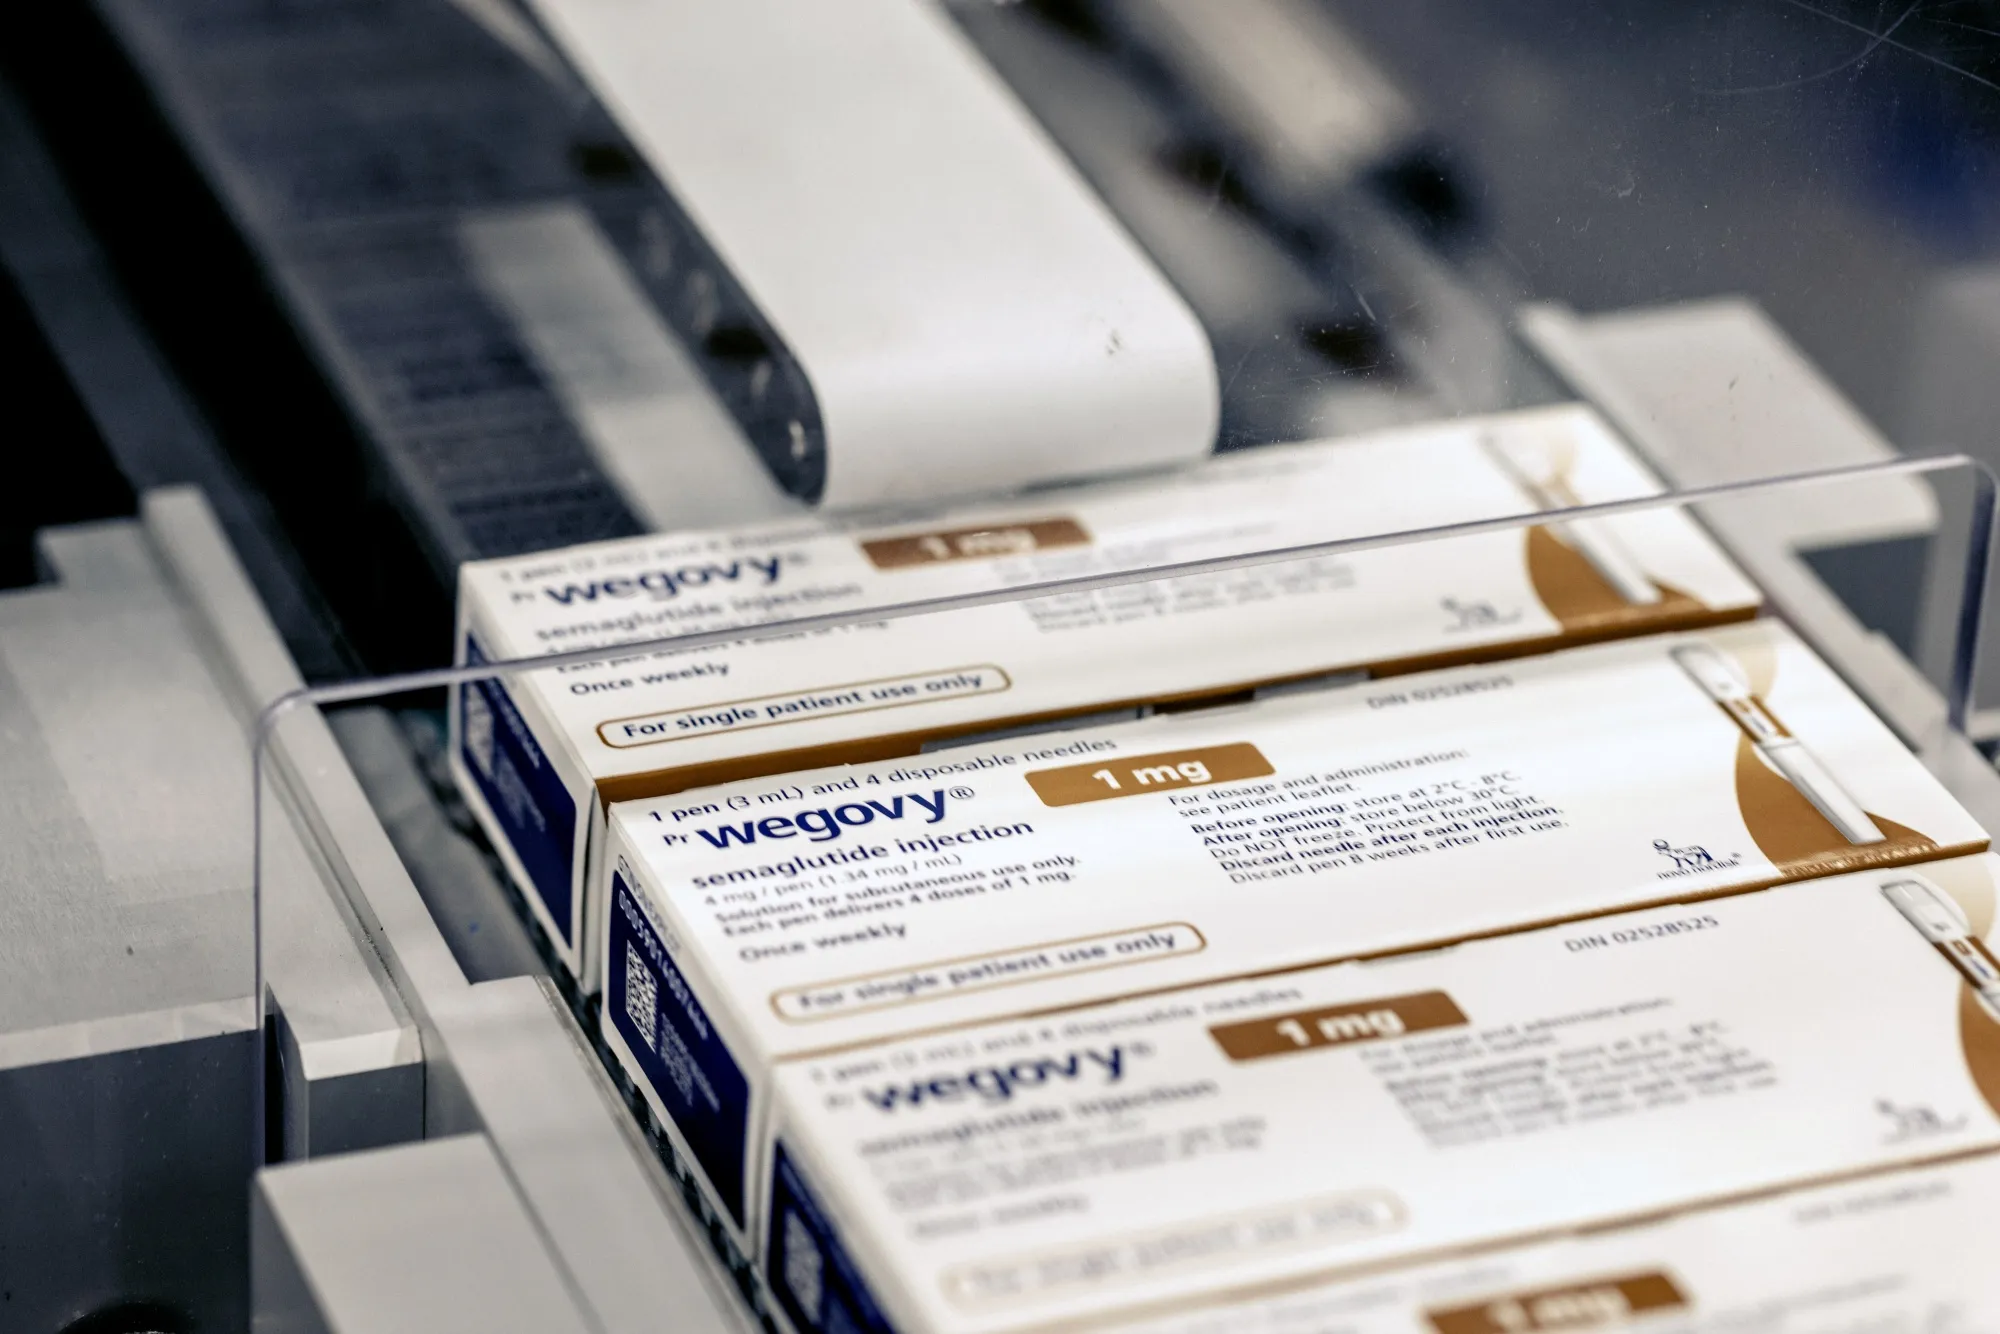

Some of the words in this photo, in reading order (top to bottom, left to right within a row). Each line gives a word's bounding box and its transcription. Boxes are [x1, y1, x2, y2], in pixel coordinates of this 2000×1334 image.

[569, 678, 634, 696] Once
[640, 661, 729, 685] weekly
[623, 721, 666, 738] For
[676, 704, 758, 731] single
[765, 690, 865, 720] patient
[871, 684, 917, 700] use
[925, 671, 983, 695] only
[649, 810, 661, 822] 1
[671, 801, 720, 823] pen
[726, 795, 750, 814] (3
[757, 784, 804, 806] mL)
[812, 776, 860, 796] and
[866, 773, 881, 786] 4
[888, 753, 1017, 784] disposable
[1023, 739, 1117, 763] needles
[1092, 769, 1122, 790] 1
[1131, 760, 1213, 787] mg
[1168, 793, 1200, 807] For
[1207, 781, 1276, 803] dosage
[1281, 773, 1318, 789] and
[1178, 805, 1212, 819] see
[1217, 792, 1288, 815] patient
[1291, 781, 1362, 802] leaflet.
[1190, 815, 1257, 835] Before
[1262, 801, 1349, 825] opening:
[1354, 791, 1402, 810] store
[1407, 787, 1427, 800] at
[1202, 830, 1253, 847] After
[1259, 816, 1345, 839] opening:
[1350, 806, 1400, 825] store
[1403, 794, 1464, 815] below
[1208, 846, 1240, 860] Do
[1244, 838, 1286, 854] NOT
[1294, 828, 1362, 848] freeze.
[1364, 812, 1437, 835] Protect
[1440, 804, 1489, 822] from
[1491, 794, 1545, 814] light.
[662, 833, 689, 847] Pr
[692, 841, 890, 890] semaglutide
[898, 818, 1036, 856] injection
[1219, 849, 1294, 872] Discard
[1300, 838, 1366, 860] needle
[1371, 830, 1418, 849] after
[1422, 820, 1469, 839] each
[1473, 805, 1565, 831] injection.
[1228, 862, 1303, 885] Discard
[1307, 856, 1347, 876] pen
[1350, 853, 1364, 865] 8
[1367, 842, 1431, 863] weeks
[1434, 832, 1481, 851] after
[1485, 823, 1527, 841] first
[1529, 817, 1569, 833] use.
[714, 898, 803, 925] Solution
[808, 895, 838, 911] for
[845, 870, 987, 902] subcutaneous
[992, 864, 1028, 879] use
[1032, 853, 1081, 874] only.
[773, 880, 813, 899] pen
[875, 862, 908, 879] mg
[922, 853, 963, 871] mL)
[723, 919, 773, 938] Each
[778, 913, 818, 932] pen
[823, 896, 901, 922] delivers
[908, 894, 923, 906] 4
[927, 882, 987, 903] doses
[992, 878, 1014, 893] of
[1037, 868, 1078, 887] mg.
[738, 940, 807, 963] Once
[814, 922, 908, 950] weekly
[1564, 934, 1609, 953] DIN
[796, 991, 845, 1011] For
[855, 973, 939, 1003] single
[948, 953, 1052, 987] patient
[1058, 945, 1107, 964] use
[1113, 931, 1177, 956] only
[1275, 1017, 1310, 1046] 1
[1316, 1008, 1406, 1040] mg
